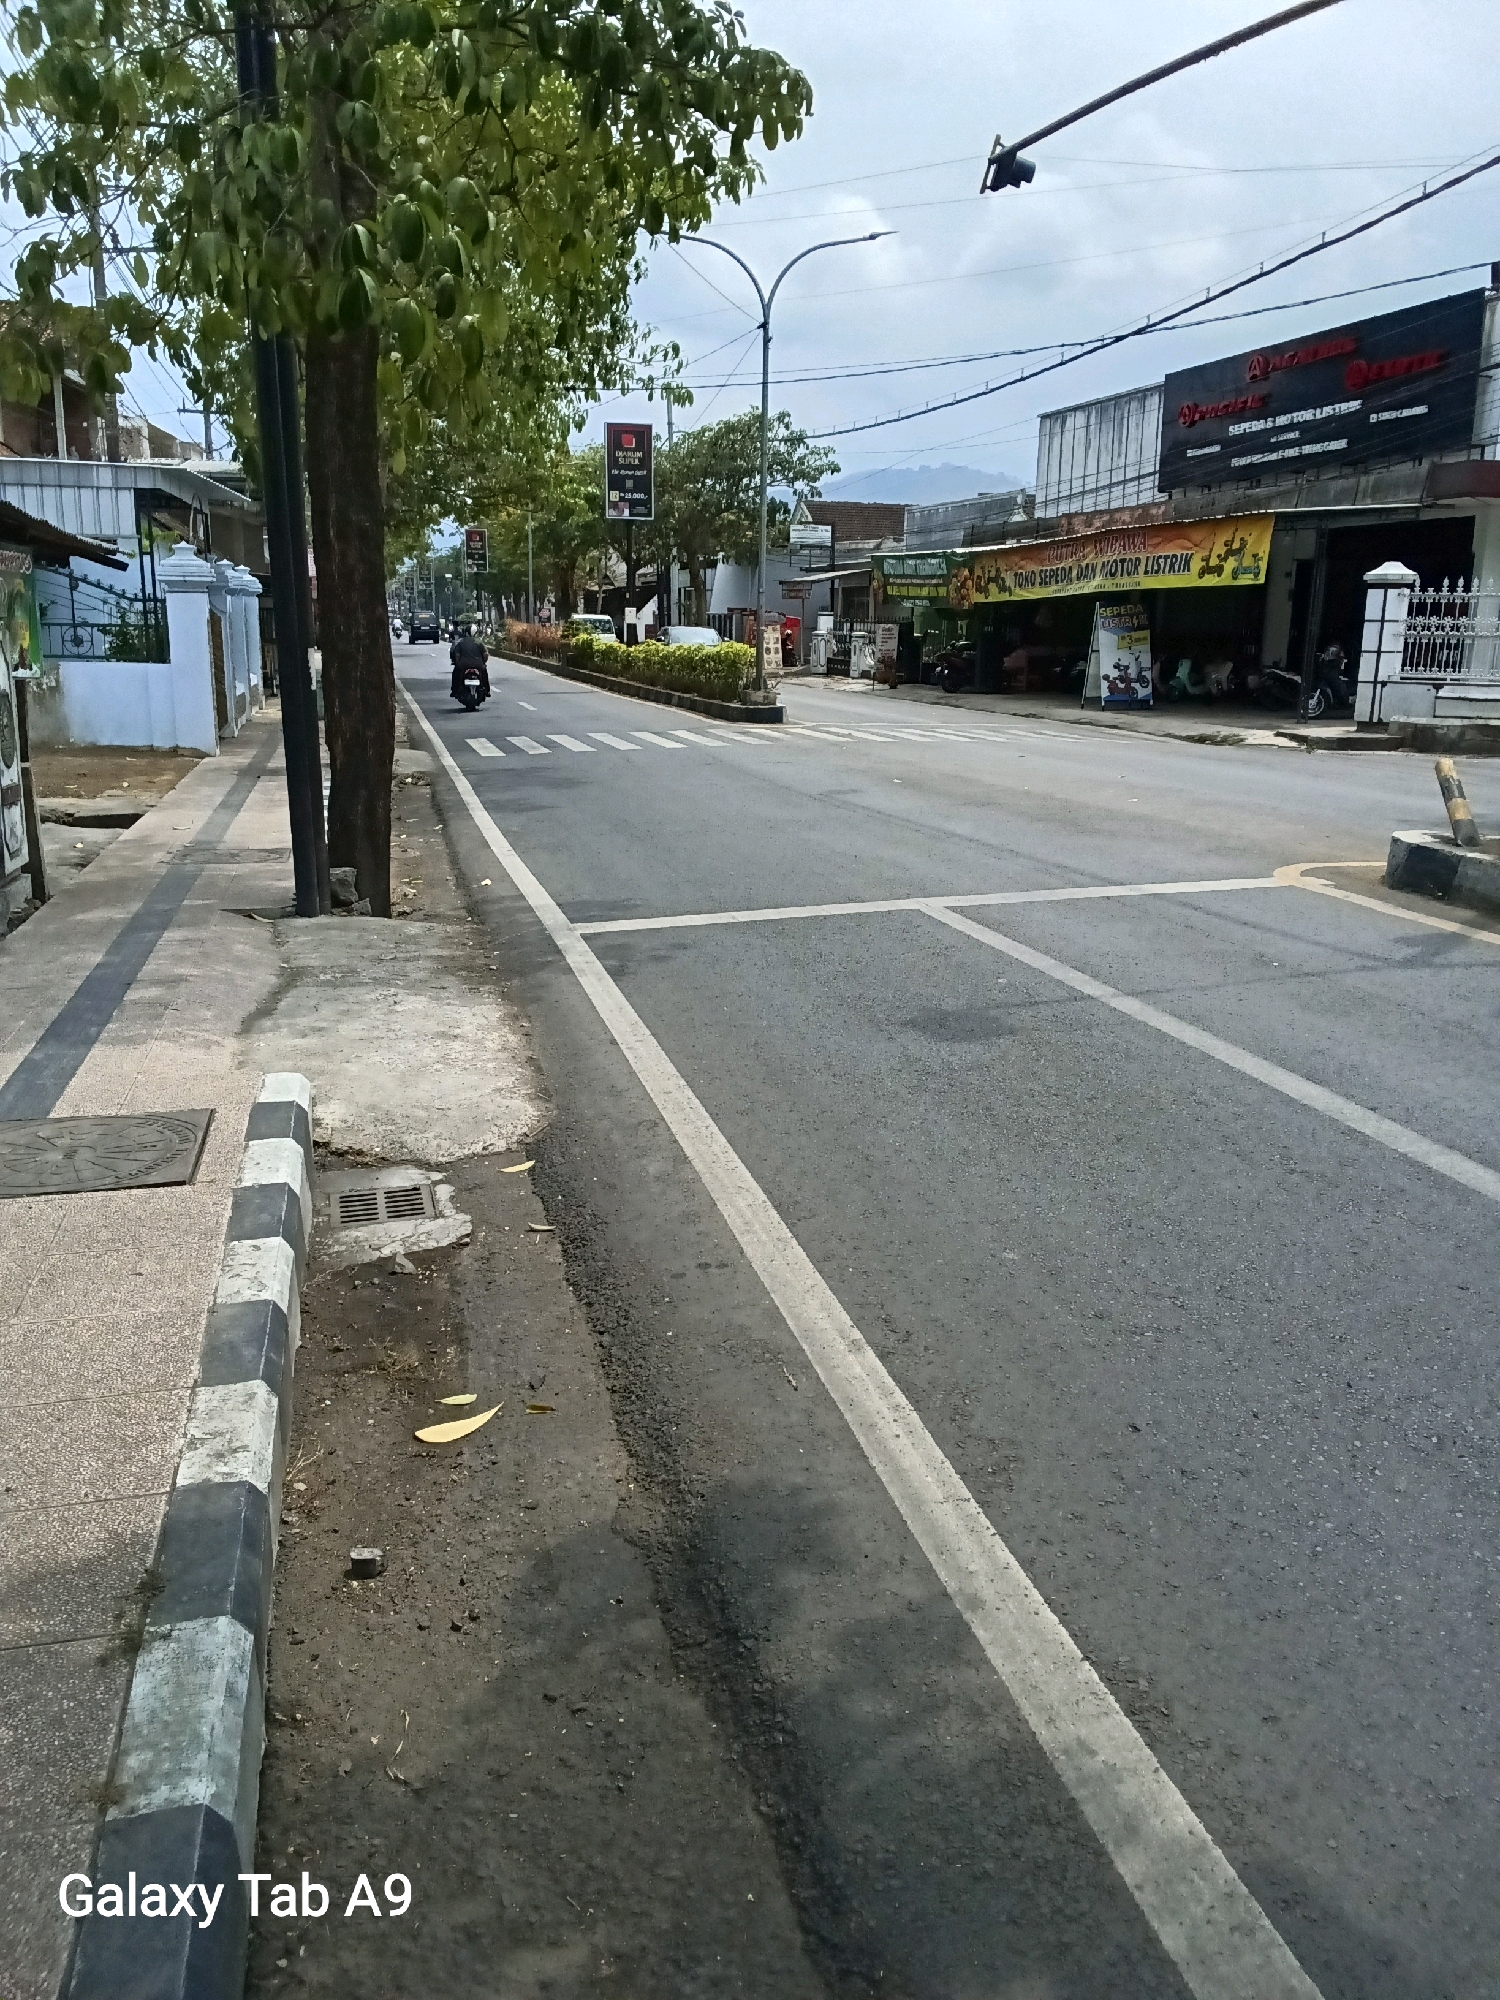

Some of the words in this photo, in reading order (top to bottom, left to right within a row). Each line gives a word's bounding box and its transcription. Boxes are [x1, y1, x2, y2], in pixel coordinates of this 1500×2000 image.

[1228, 419, 1267, 436] SEPEDA
[1048, 541, 1087, 564] PUTRA
[1093, 531, 1148, 559] WIBAWA
[1013, 569, 1037, 590] TOKO
[1038, 565, 1073, 588] SEPEDA
[1077, 561, 1097, 582] DAN
[1099, 556, 1142, 580] MOTOR
[1143, 551, 1195, 577] LISTRIK
[1100, 604, 1144, 617] SEPEDA
